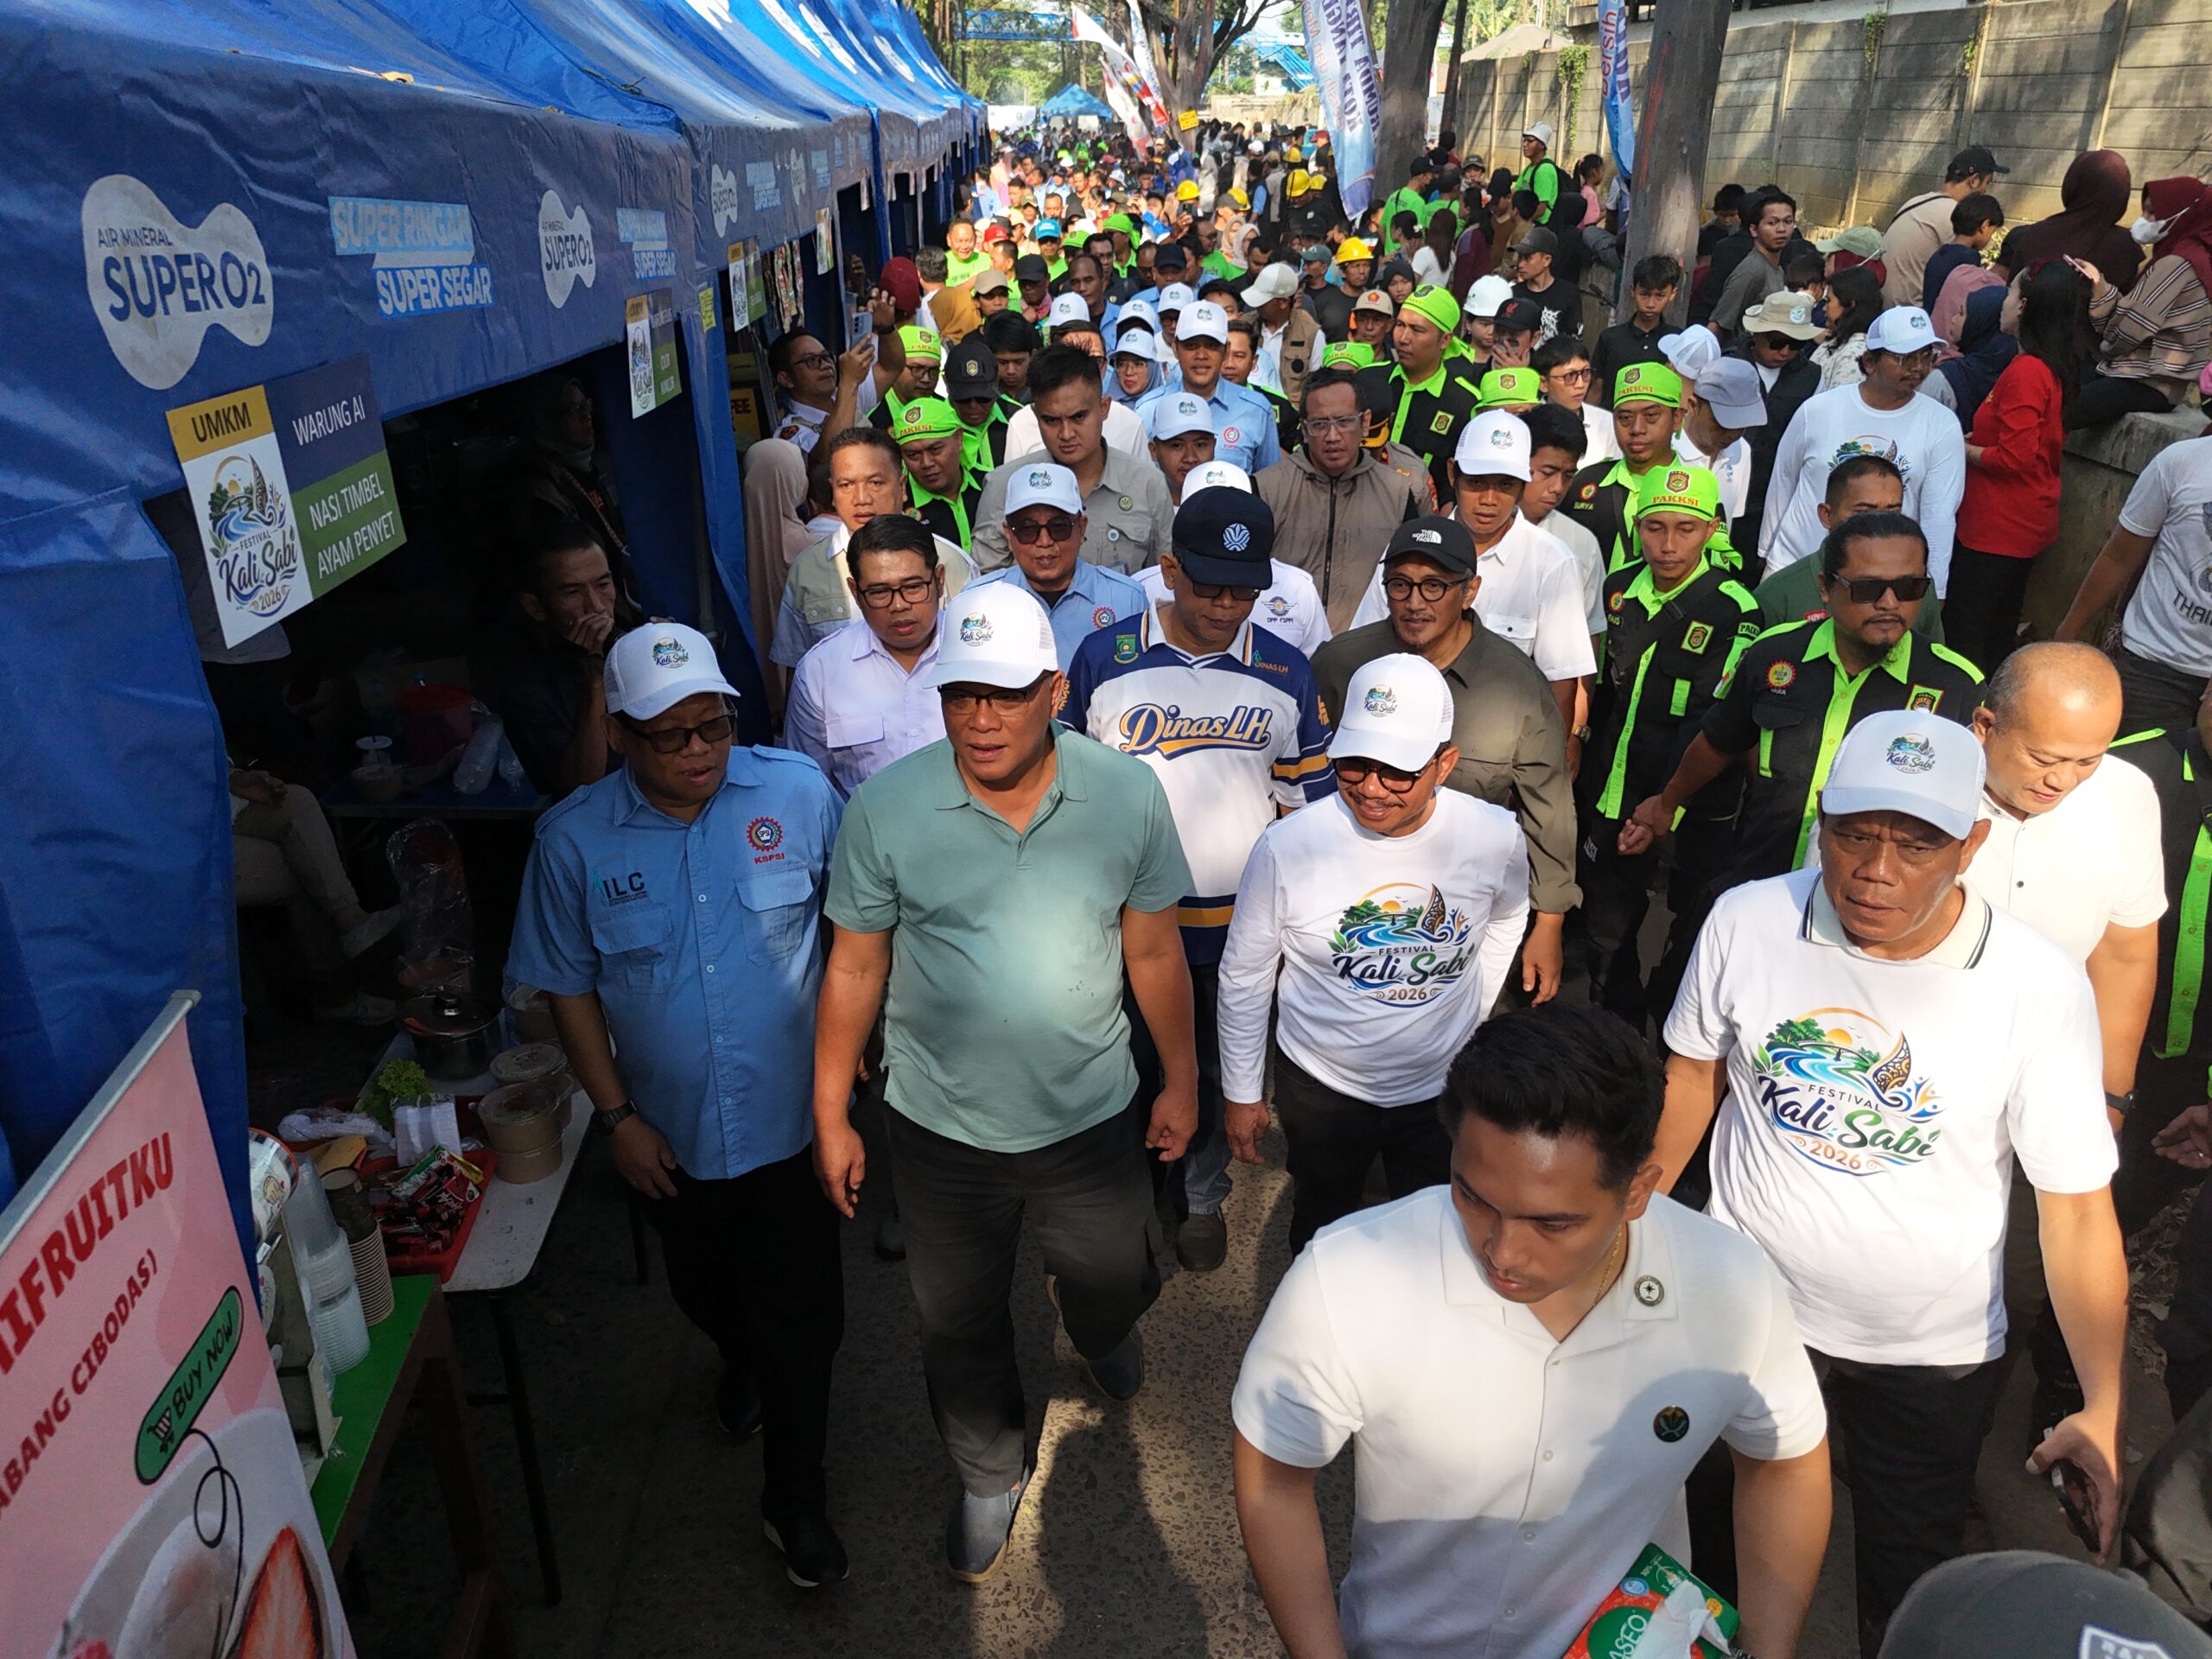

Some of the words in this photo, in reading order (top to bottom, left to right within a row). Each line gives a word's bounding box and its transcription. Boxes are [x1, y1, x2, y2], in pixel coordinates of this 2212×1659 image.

[98, 227, 117, 248] AIR
[120, 227, 173, 247] MINERAL
[333, 201, 402, 249] SUPER
[404, 206, 470, 246] RINGAN
[376, 269, 443, 315] SUPER
[442, 266, 493, 308] SEGAR
[191, 401, 251, 443] UMKM
[293, 400, 351, 446] WARUNG
[353, 395, 366, 420] AI
[899, 424, 932, 435] PAKKSI
[309, 498, 342, 531] NASI
[344, 472, 385, 516] TIMBEL
[1573, 502, 1594, 511] SURYA
[1652, 495, 1699, 506] PAKKSI
[239, 531, 271, 551] FESTIVAL
[316, 537, 353, 580] AYAM
[355, 511, 396, 563] PENYET
[217, 551, 259, 602] Kali
[262, 525, 297, 587] Sabi
[260, 587, 282, 611] 2026
[2173, 587, 2212, 626] THAI
[654, 655, 672, 665] Kali
[1886, 752, 1910, 764] Kali
[1909, 757, 1936, 769] Sabi
[754, 852, 785, 864] KSPSI
[1332, 953, 1404, 981] Kali
[1407, 943, 1474, 986] Sabi
[1379, 945, 1435, 956] FESTIVAL
[1388, 988, 1427, 1001] 2026
[1808, 1084, 1881, 1113] FESTIVAL
[1758, 1075, 1835, 1131] Kali
[1837, 1109, 1942, 1157] Sabi
[1809, 1140, 1861, 1170] 2026
[71, 1248, 158, 1396] CIBODAS)
[173, 1359, 203, 1420] BUY
[207, 1314, 233, 1374] NOW
